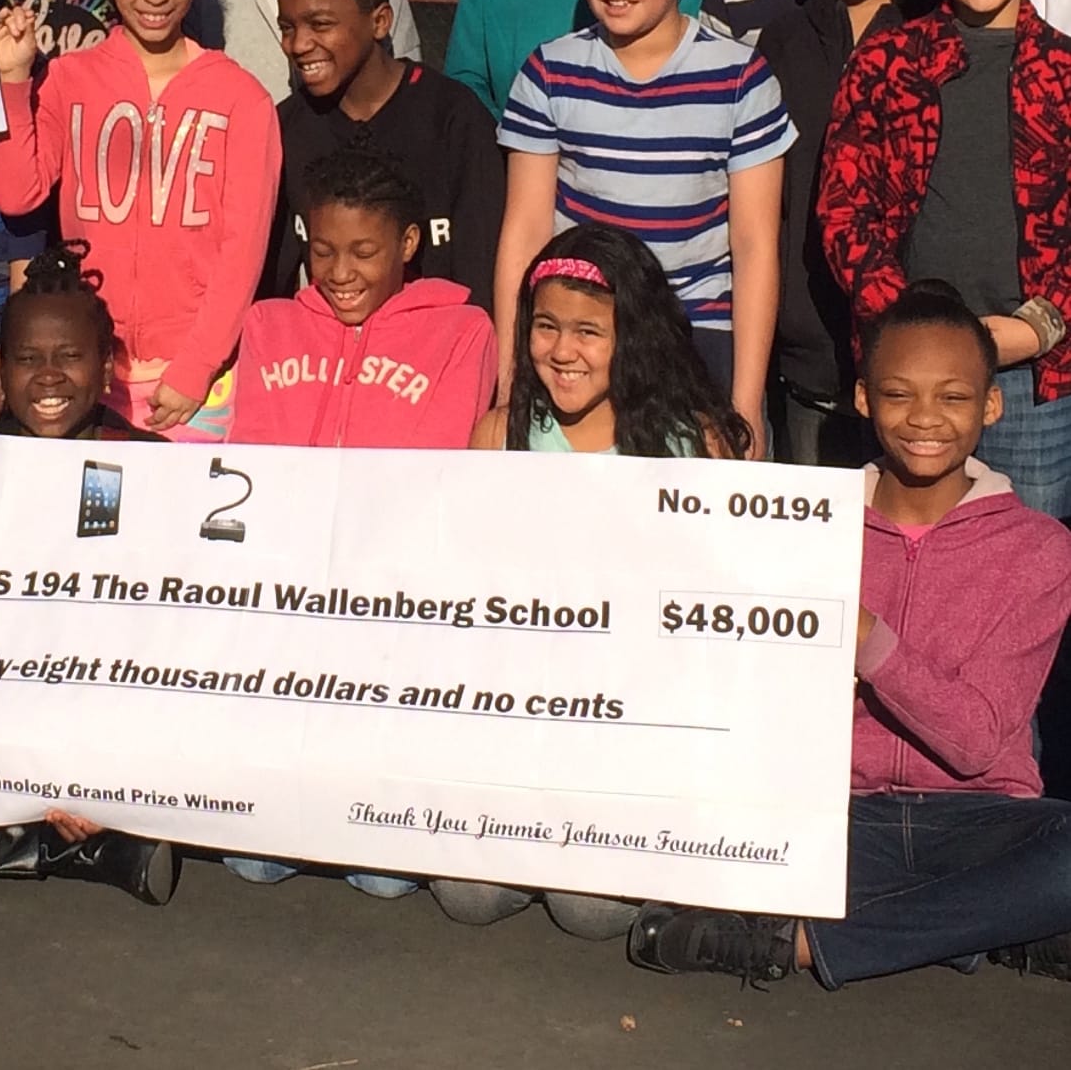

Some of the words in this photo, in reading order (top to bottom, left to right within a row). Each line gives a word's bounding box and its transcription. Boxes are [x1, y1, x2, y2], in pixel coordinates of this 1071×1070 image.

[71, 99, 231, 227] LOVE
[260, 354, 429, 405] HOLLISTER
[658, 488, 711, 515] No.
[728, 492, 832, 522] 00194
[21, 570, 81, 598] 194
[92, 573, 149, 601] The
[159, 576, 261, 608] Raoul
[274, 583, 476, 629] Wallenberg
[484, 596, 611, 629] School
[661, 600, 820, 641] $48,000
[108, 658, 266, 694] thousand
[272, 671, 391, 704] dollars
[398, 683, 466, 709] and
[471, 690, 516, 713] no
[525, 693, 625, 720] cents
[67, 783, 126, 803] Grand
[131, 789, 179, 807] Prize
[184, 793, 256, 813] Winner
[347, 802, 417, 826] Thank
[423, 808, 470, 835] You
[475, 814, 554, 840] Jimmie
[560, 821, 648, 849] Johnson
[654, 830, 790, 863] Foundation!
